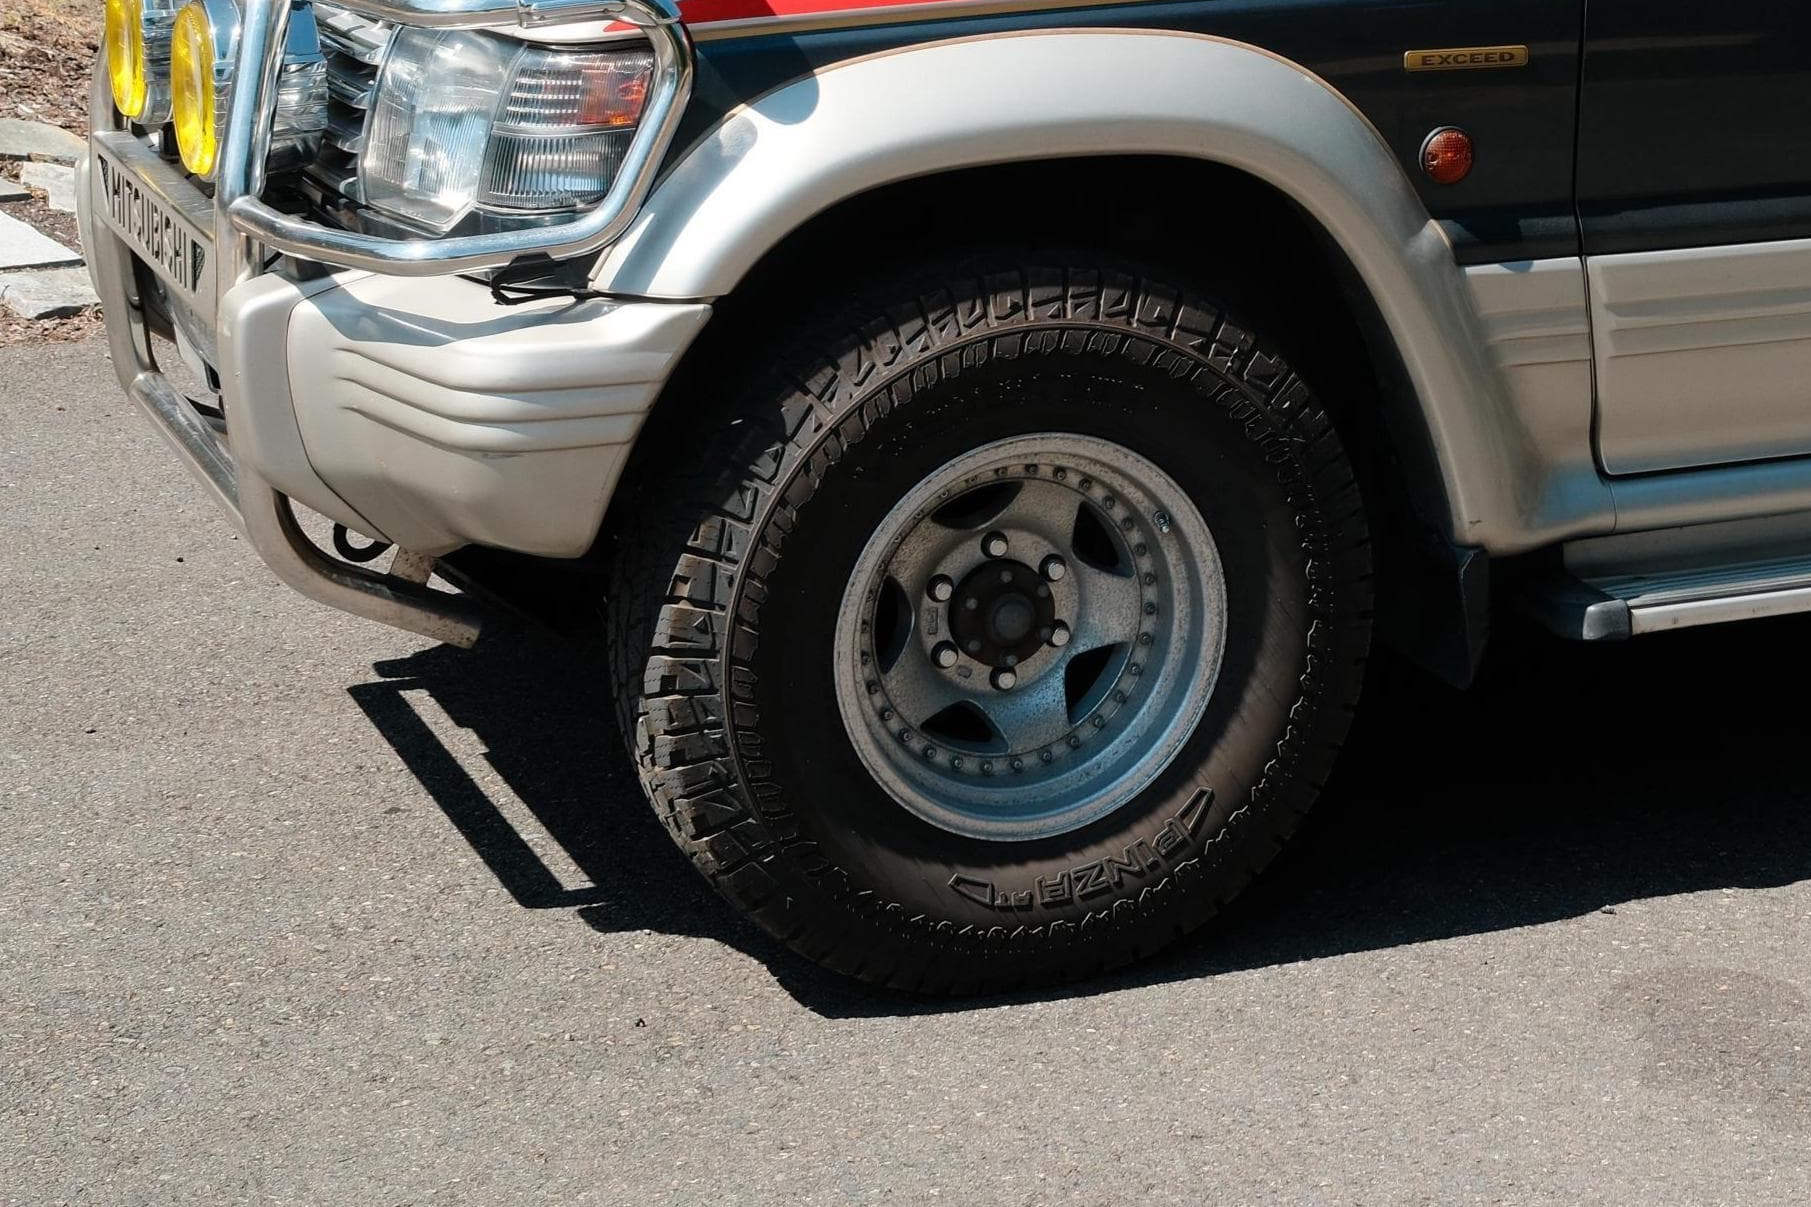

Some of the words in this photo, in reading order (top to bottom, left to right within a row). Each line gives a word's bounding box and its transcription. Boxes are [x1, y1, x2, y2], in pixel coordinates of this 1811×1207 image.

[1421, 52, 1515, 66] EXCEED
[112, 166, 187, 289] MITSUBISHI
[1035, 817, 1192, 906] PINZA
